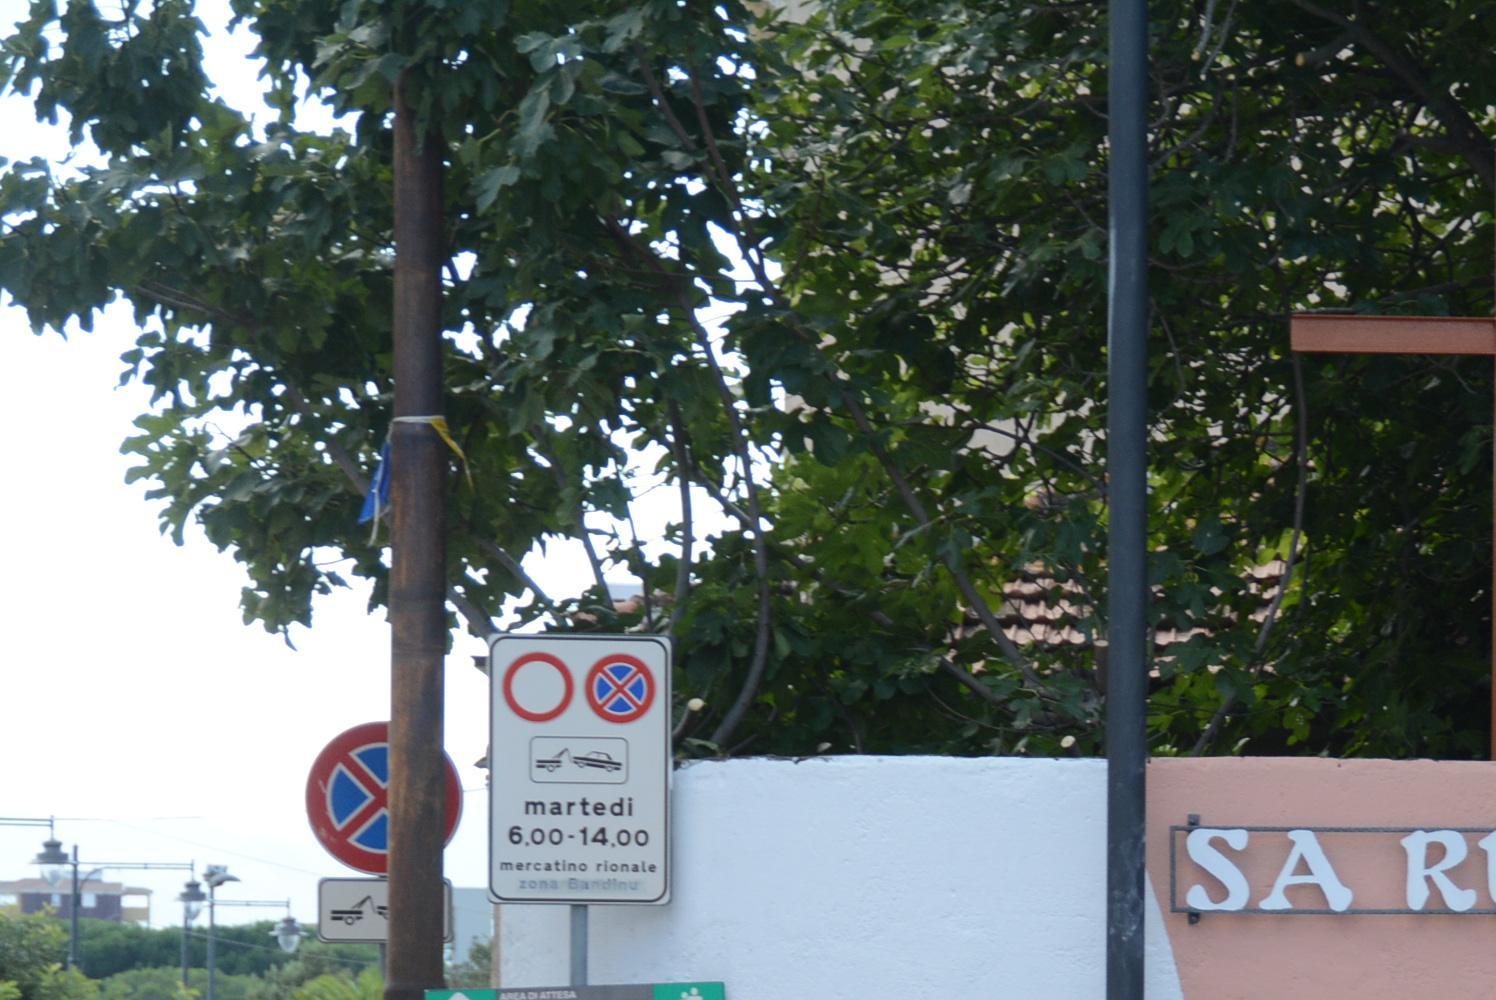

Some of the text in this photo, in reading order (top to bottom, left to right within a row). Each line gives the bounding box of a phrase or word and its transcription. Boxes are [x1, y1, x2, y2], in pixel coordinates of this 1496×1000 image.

[524, 797, 634, 817] martedi
[500, 859, 658, 873] mercatino rionale
[1185, 829, 1354, 912] SA
[500, 992, 526, 1000] AREA
[540, 990, 577, 1000] ATTESA
